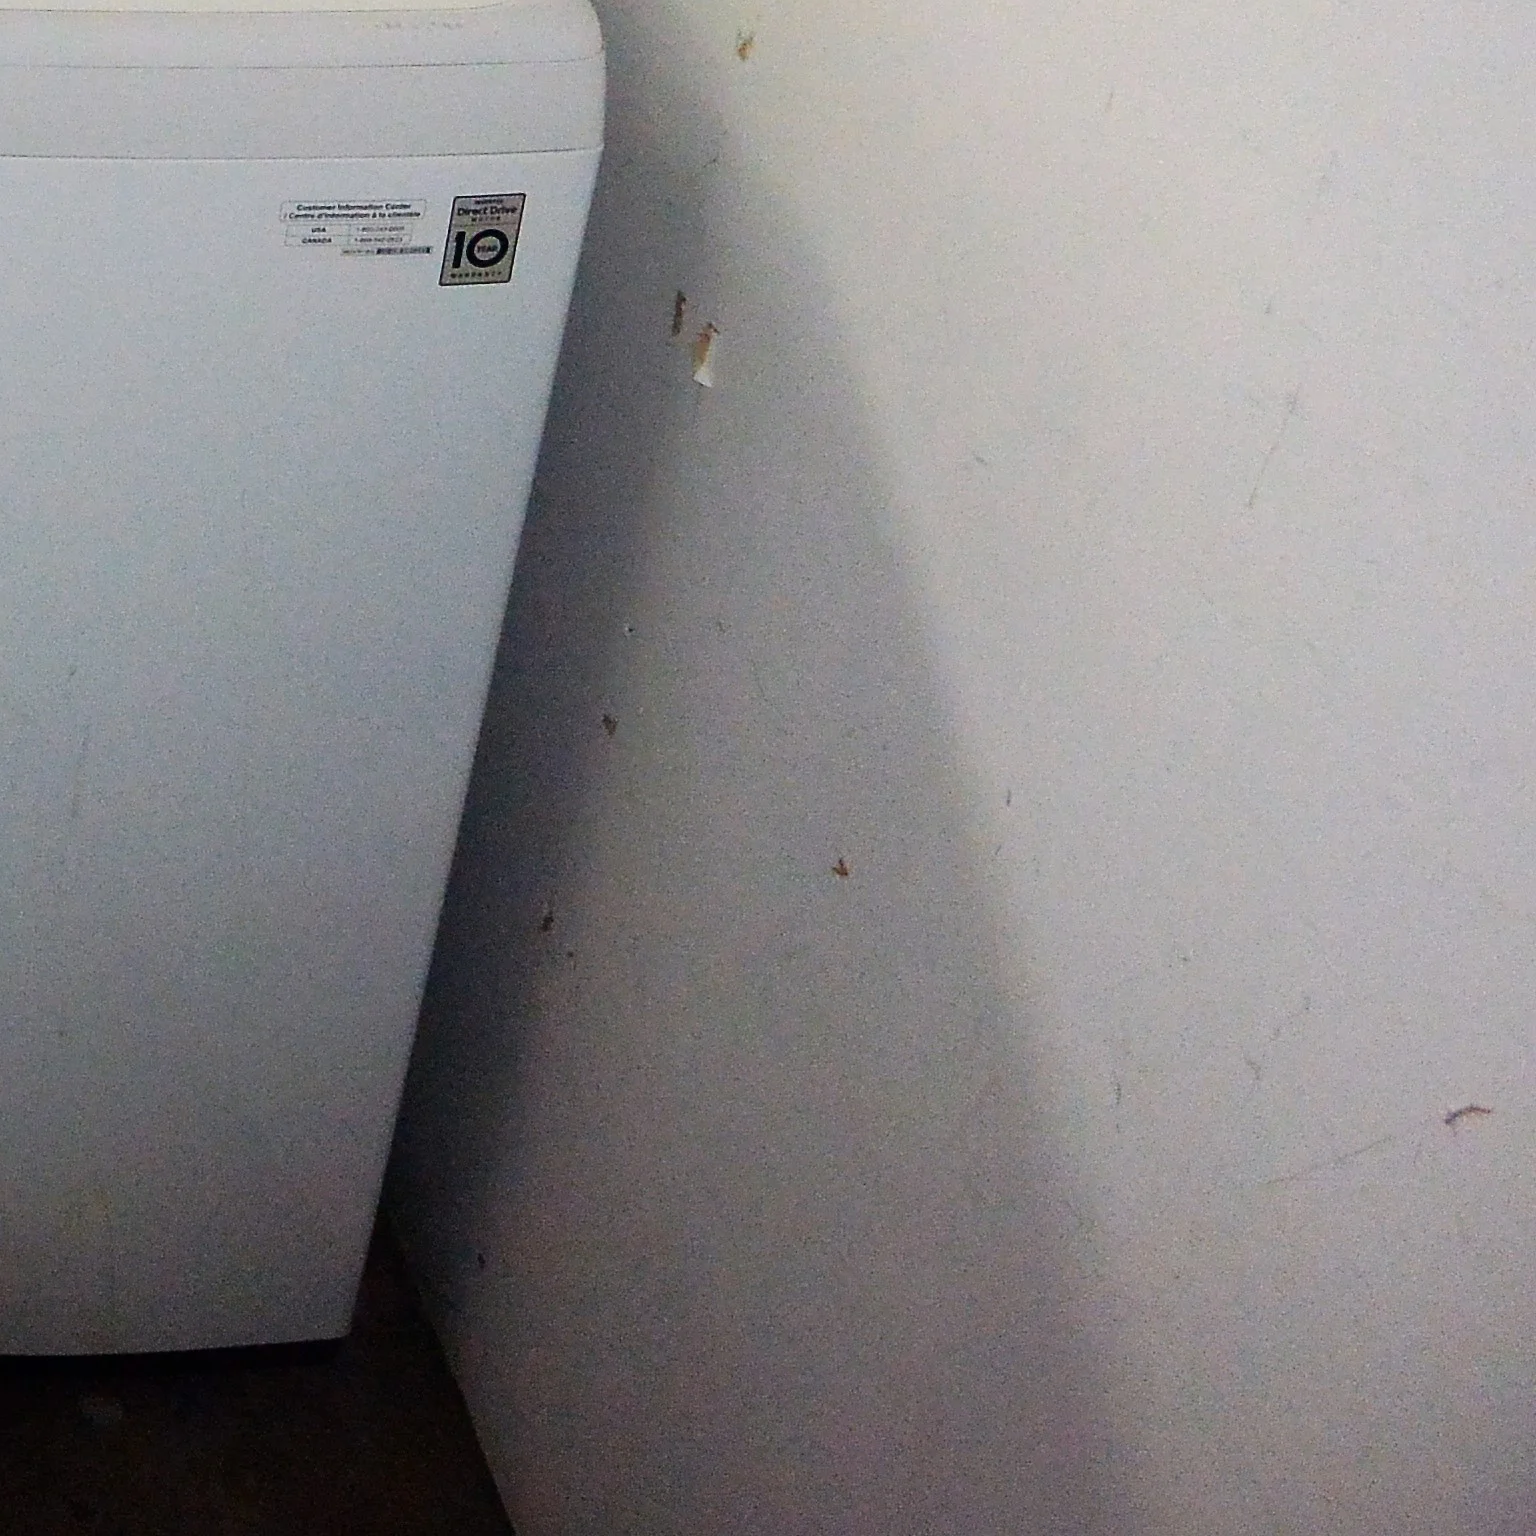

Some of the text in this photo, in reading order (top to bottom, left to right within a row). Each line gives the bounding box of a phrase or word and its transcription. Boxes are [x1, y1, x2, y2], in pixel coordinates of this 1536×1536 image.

[296, 204, 336, 212] Customer
[457, 206, 518, 216] Direct Drive
[452, 229, 509, 268] 10
